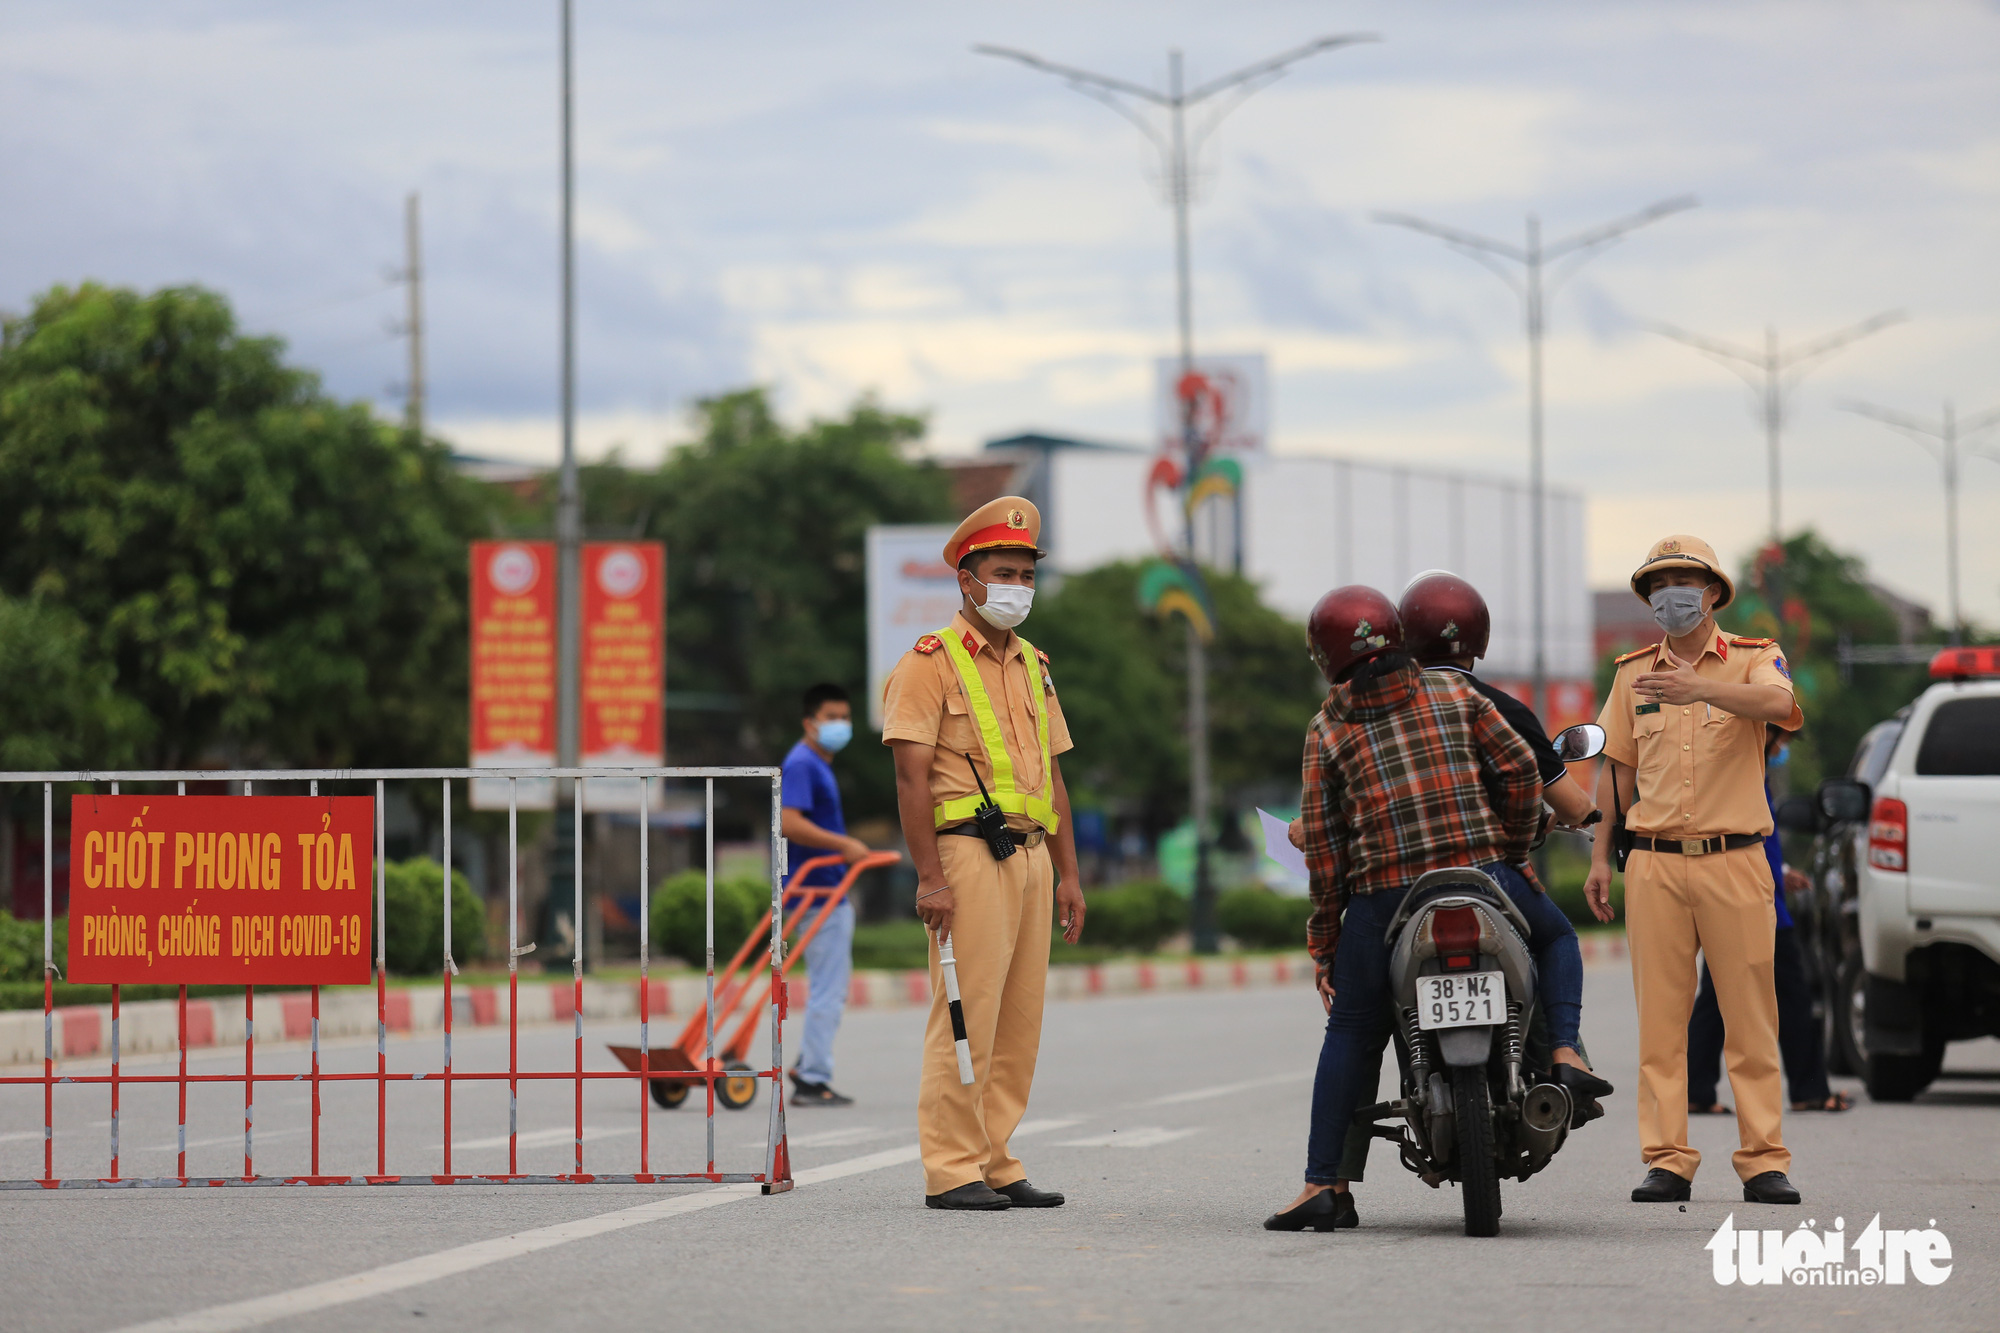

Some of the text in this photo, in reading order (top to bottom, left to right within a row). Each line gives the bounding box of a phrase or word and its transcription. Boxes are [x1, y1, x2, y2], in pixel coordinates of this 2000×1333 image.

[83, 805, 356, 891] CHỐT PHONG TỎA
[82, 898, 361, 968] PHÒNG, CHỐNG DỊCH COVID-19
[1430, 975, 1491, 1000] 38-N4
[1431, 1000, 1492, 1024] 9521
